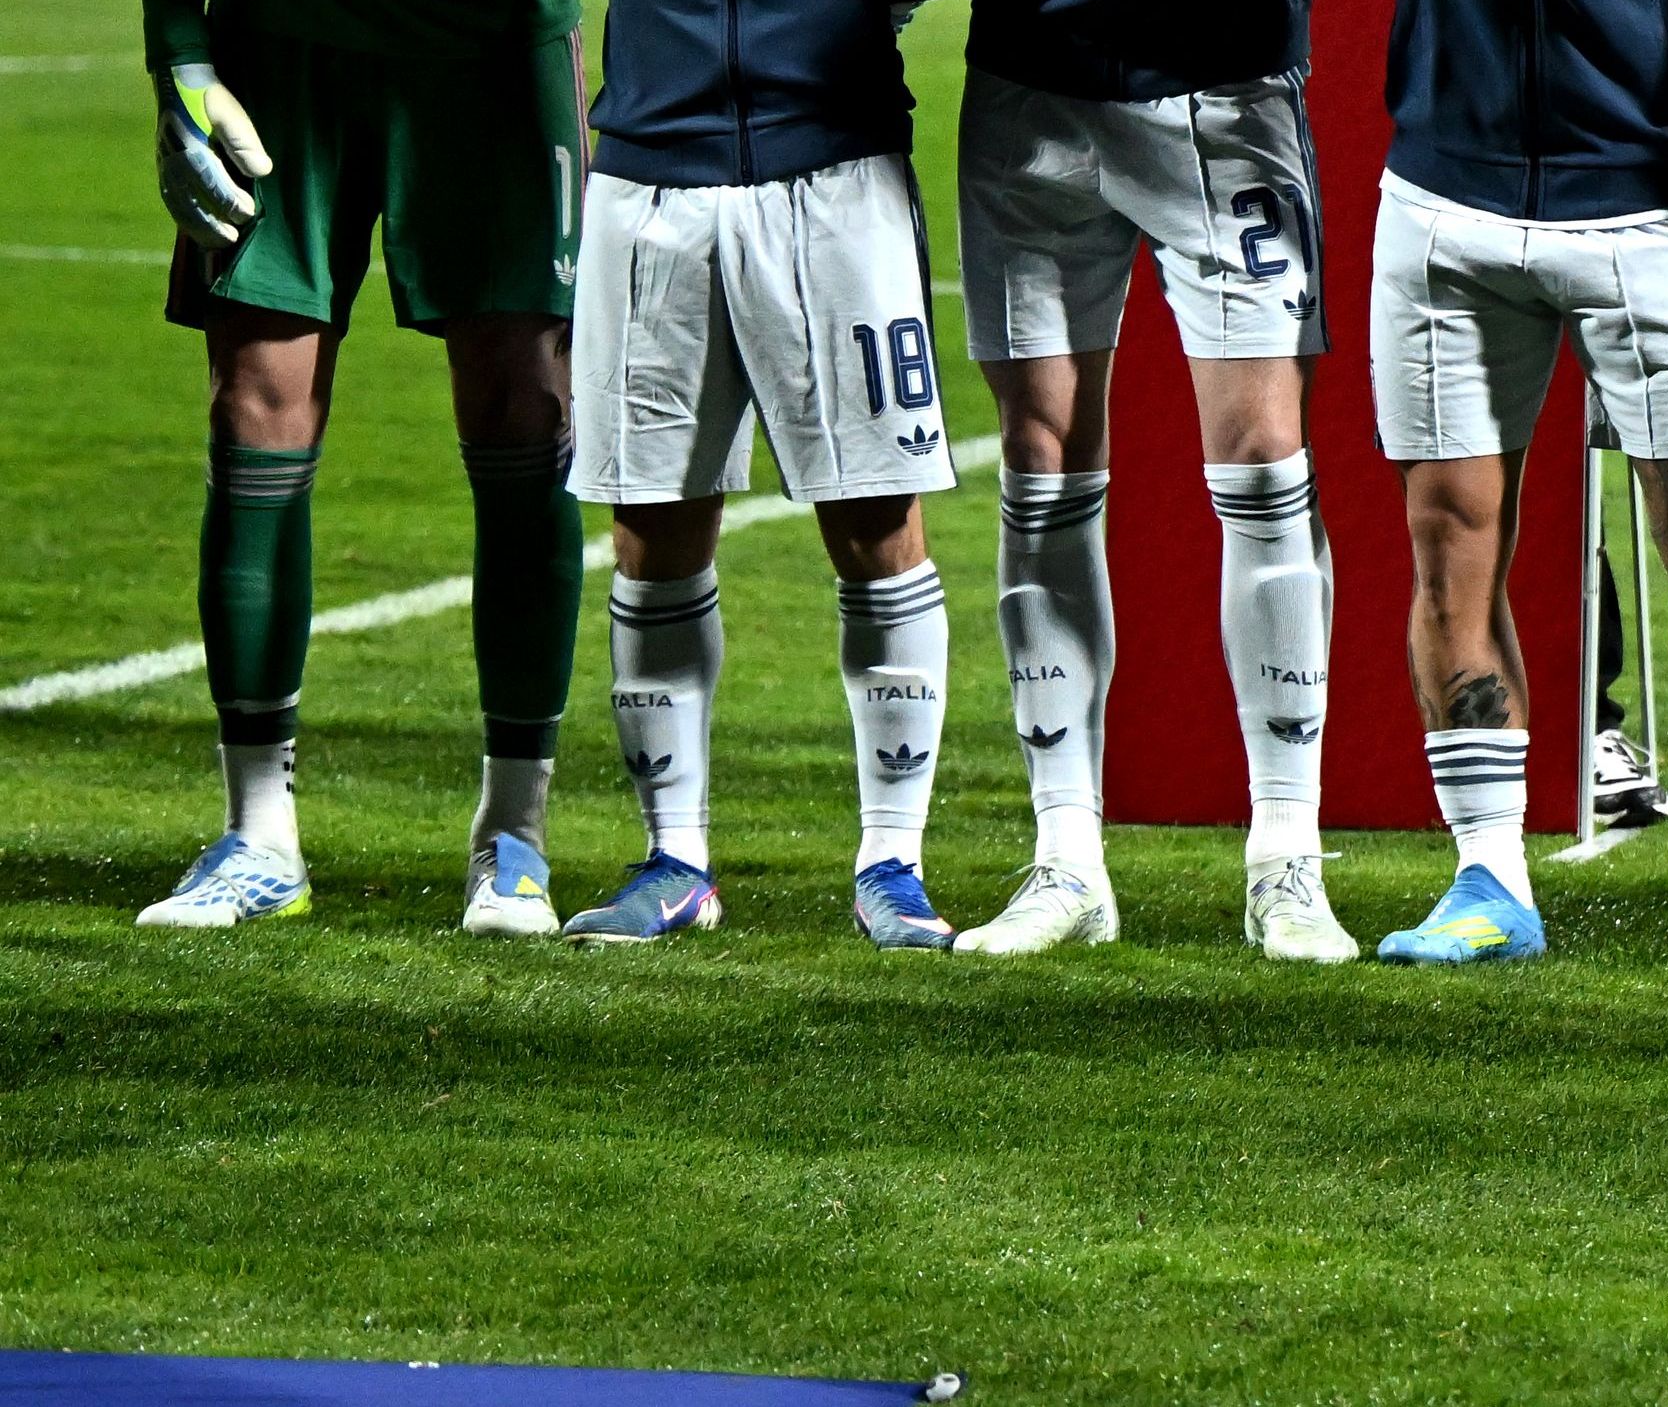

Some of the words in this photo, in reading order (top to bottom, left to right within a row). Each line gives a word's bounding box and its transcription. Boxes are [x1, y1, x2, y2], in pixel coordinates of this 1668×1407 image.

[555, 145, 572, 240] 1
[1231, 184, 1313, 280] 21
[851, 316, 935, 419] 18
[868, 685, 937, 702] ITALIA
[1261, 663, 1328, 687] ITALIA
